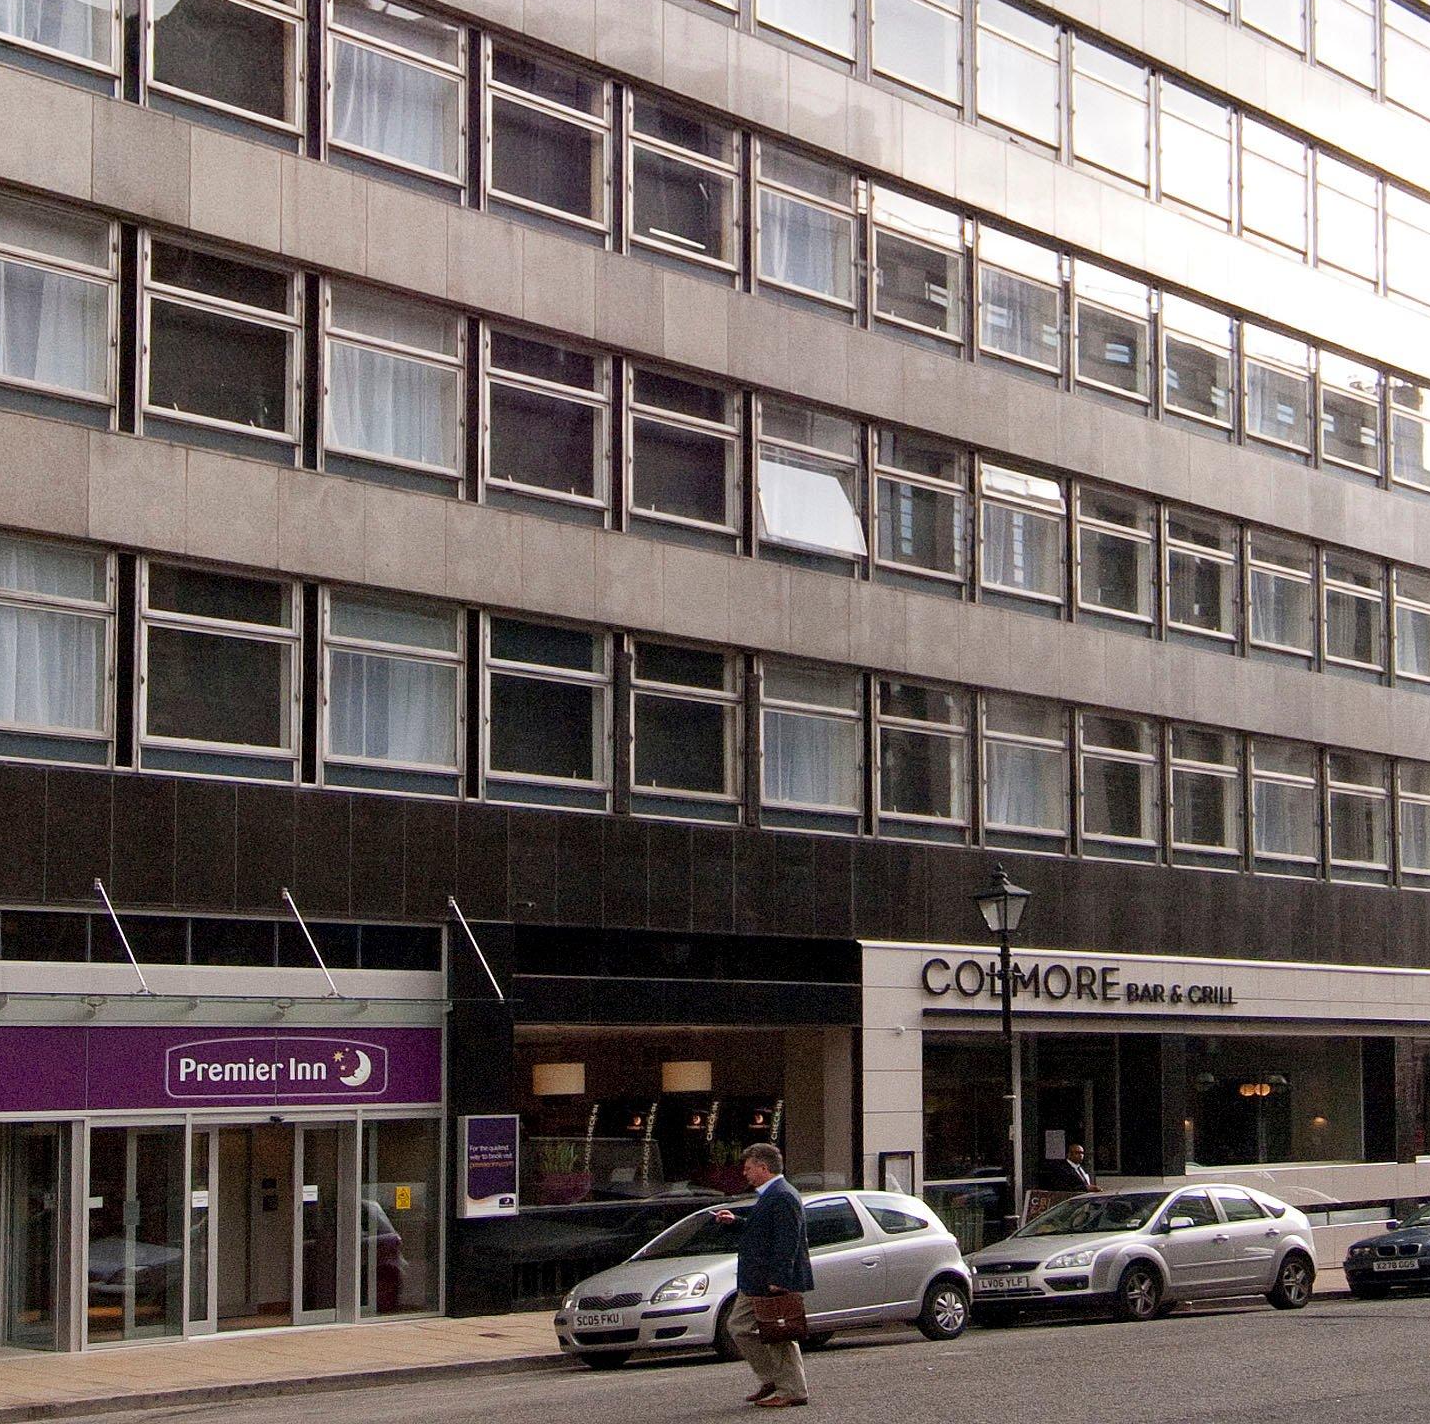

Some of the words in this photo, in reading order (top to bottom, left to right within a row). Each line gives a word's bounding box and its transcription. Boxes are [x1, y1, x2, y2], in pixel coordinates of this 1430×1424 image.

[921, 957, 1121, 1001] COLMORE
[1126, 982, 1166, 1004] BAR
[1170, 983, 1184, 1005] &
[1187, 984, 1238, 1005] GRILL
[179, 1057, 284, 1082] Premier
[289, 1057, 327, 1081] Inn
[1006, 1277, 1023, 1287] YLF
[601, 1313, 619, 1324] FKU
